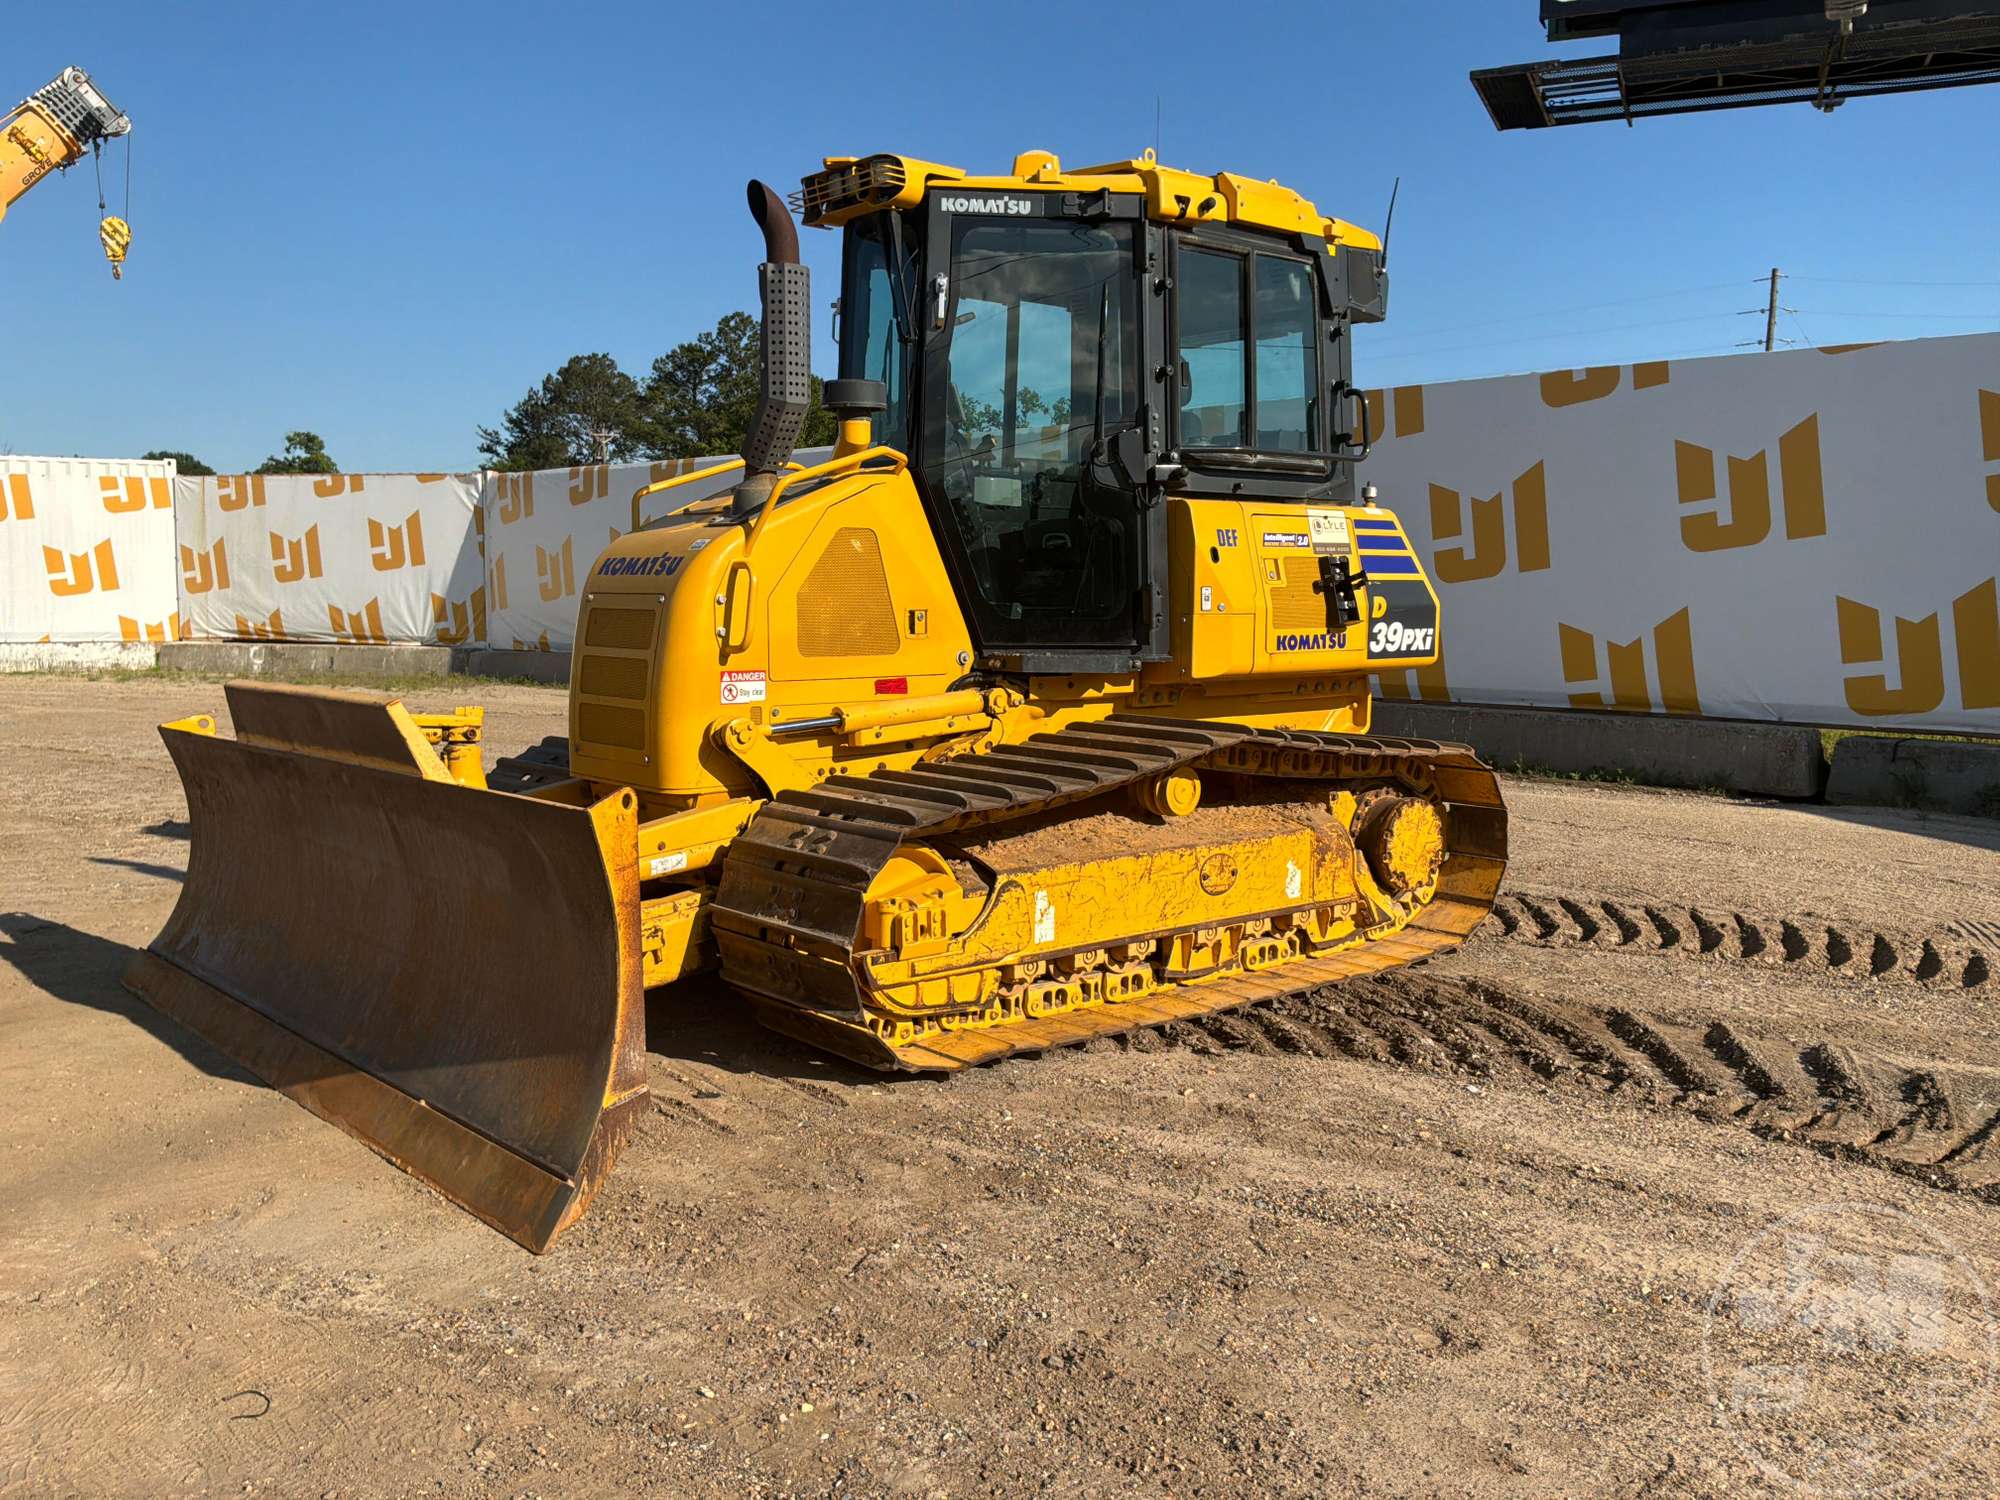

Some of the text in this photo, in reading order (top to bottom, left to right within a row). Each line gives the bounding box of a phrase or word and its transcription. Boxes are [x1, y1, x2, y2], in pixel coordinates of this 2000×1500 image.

[22, 157, 53, 185] GROVE
[941, 195, 1031, 215] KOMATSU
[1216, 529, 1238, 547] DEF
[1297, 536, 1309, 546] 2.0
[598, 552, 684, 576] KOMATSU
[1372, 596, 1387, 618] D
[1276, 633, 1347, 651] KOMATSU
[1370, 621, 1433, 653] 39PXi
[731, 672, 766, 682] DANGER
[739, 688, 750, 698] Stay
